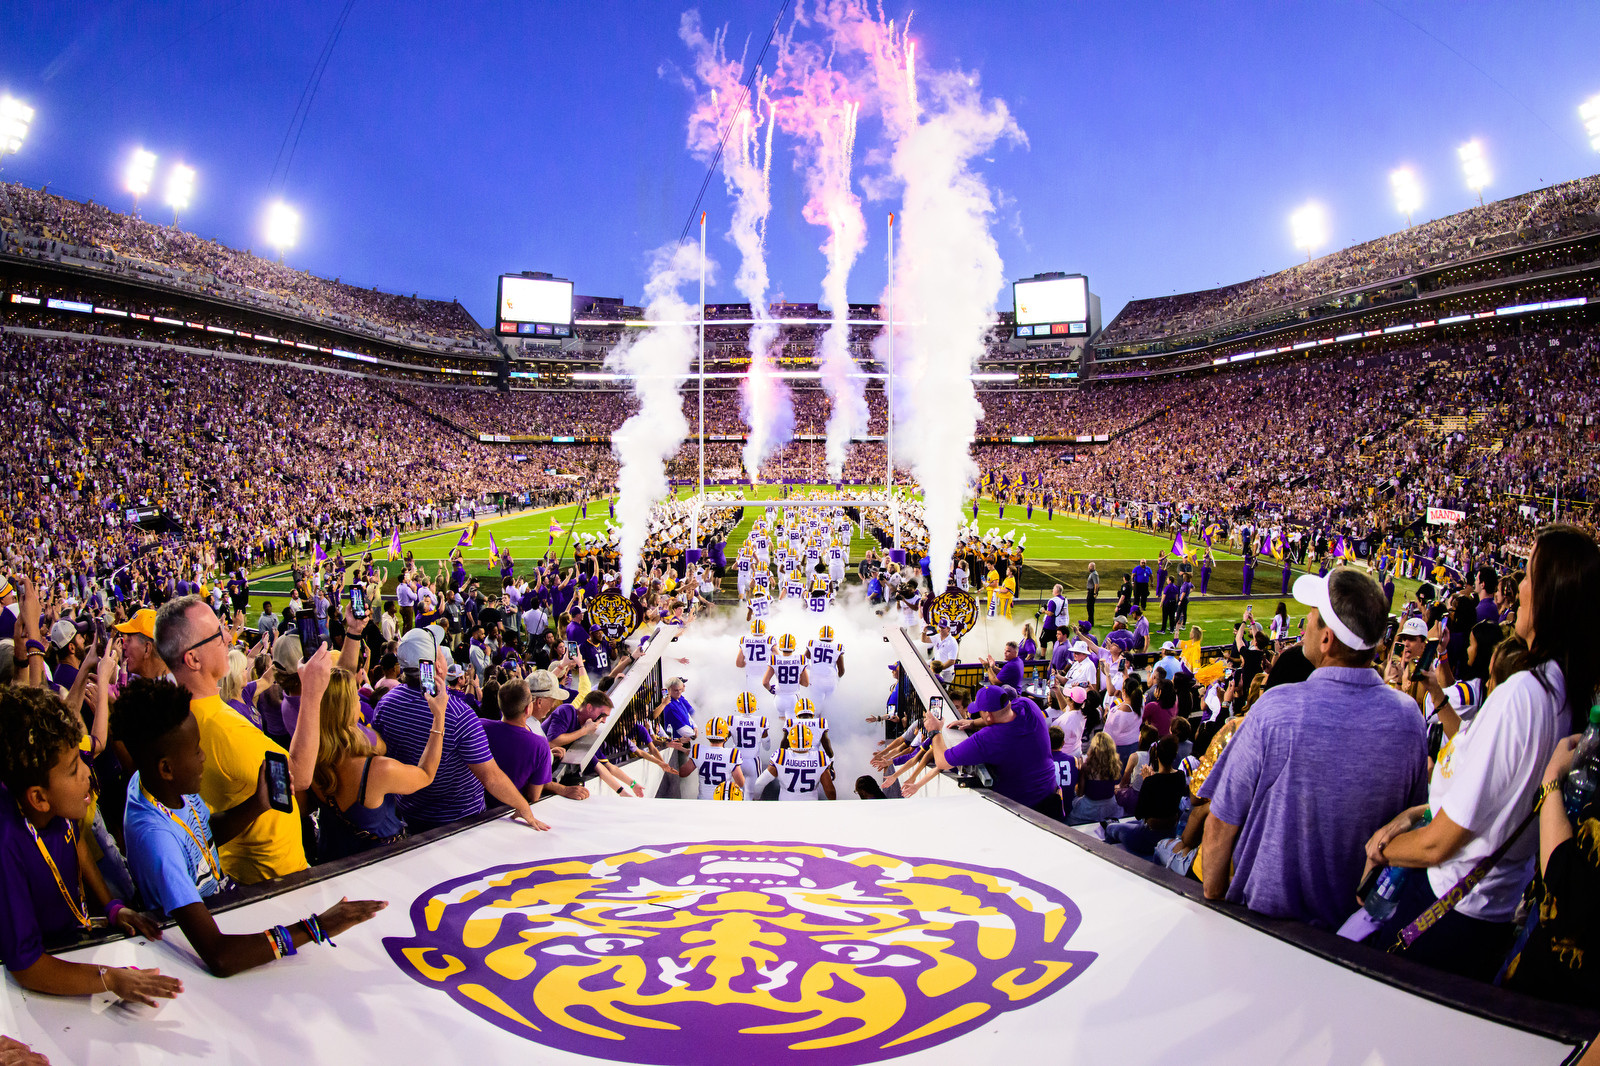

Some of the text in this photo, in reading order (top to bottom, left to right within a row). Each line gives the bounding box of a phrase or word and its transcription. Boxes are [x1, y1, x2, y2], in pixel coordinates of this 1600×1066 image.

[1549, 338, 1560, 346] 106
[756, 540, 766, 549] 78
[808, 550, 818, 559] 39
[830, 550, 840, 559] 76
[738, 561, 748, 571] 49
[786, 561, 794, 570] 21
[755, 577, 767, 588] 36
[788, 587, 802, 598] 59
[810, 599, 825, 612] 99
[746, 644, 766, 661] 72
[814, 647, 833, 664] 96
[778, 666, 799, 684] 89
[736, 727, 756, 748] 15
[705, 753, 722, 761] DAVIS
[699, 761, 726, 785] 45
[785, 768, 816, 793] 75
[1414, 887, 1462, 931] CHEER
